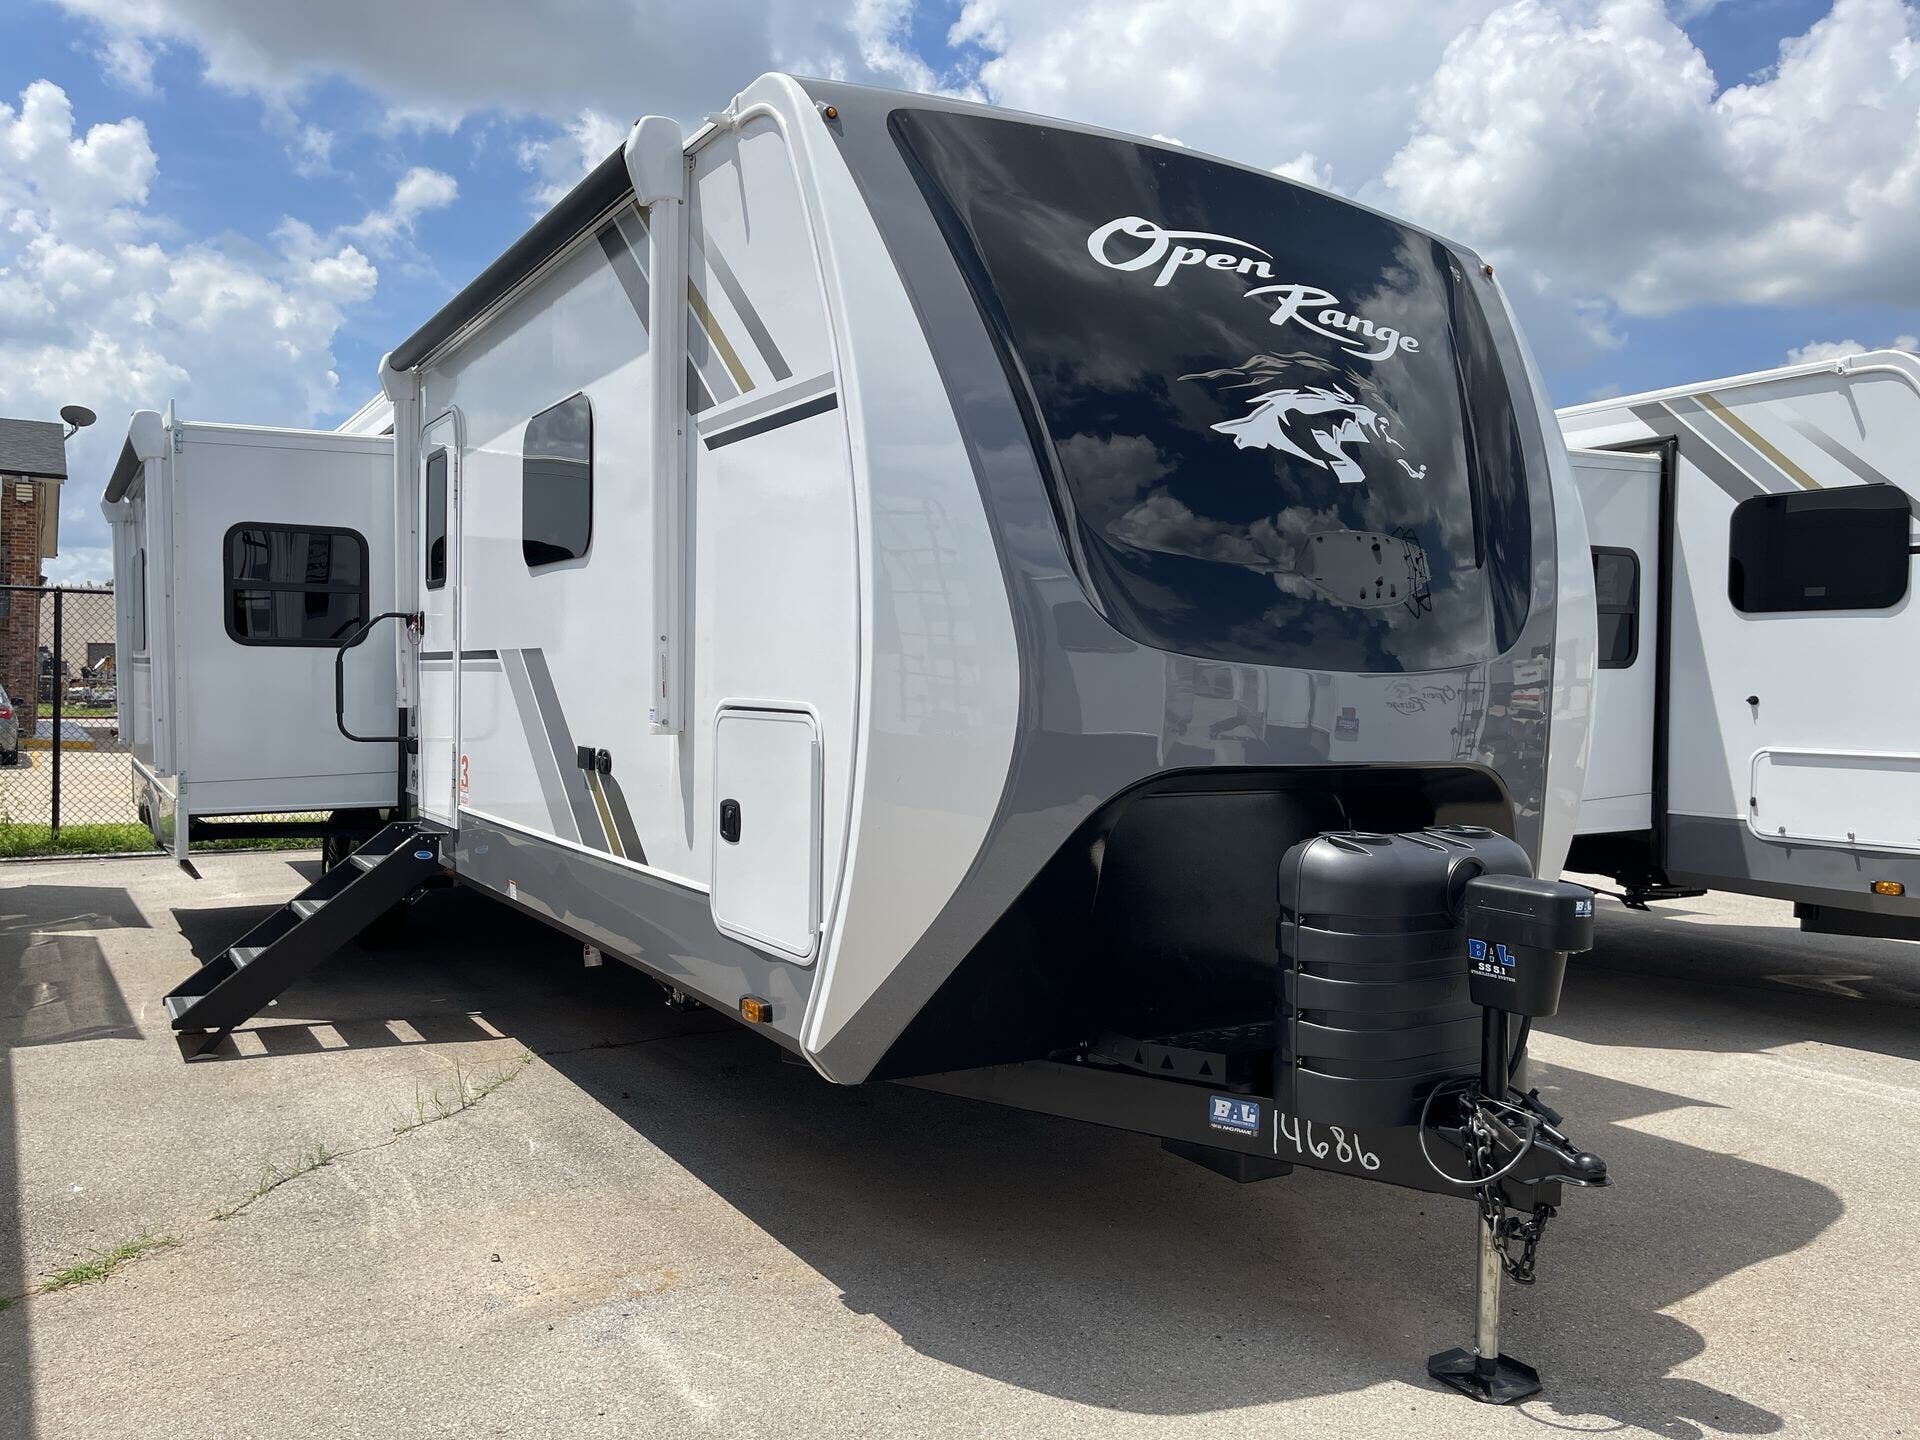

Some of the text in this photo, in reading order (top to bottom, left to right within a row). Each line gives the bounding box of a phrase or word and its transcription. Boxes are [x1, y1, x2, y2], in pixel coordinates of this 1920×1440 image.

[1087, 216, 1275, 286] Open
[1244, 284, 1419, 361] Range
[1478, 962, 1492, 972] SS
[1273, 1109, 1380, 1171] 14686
